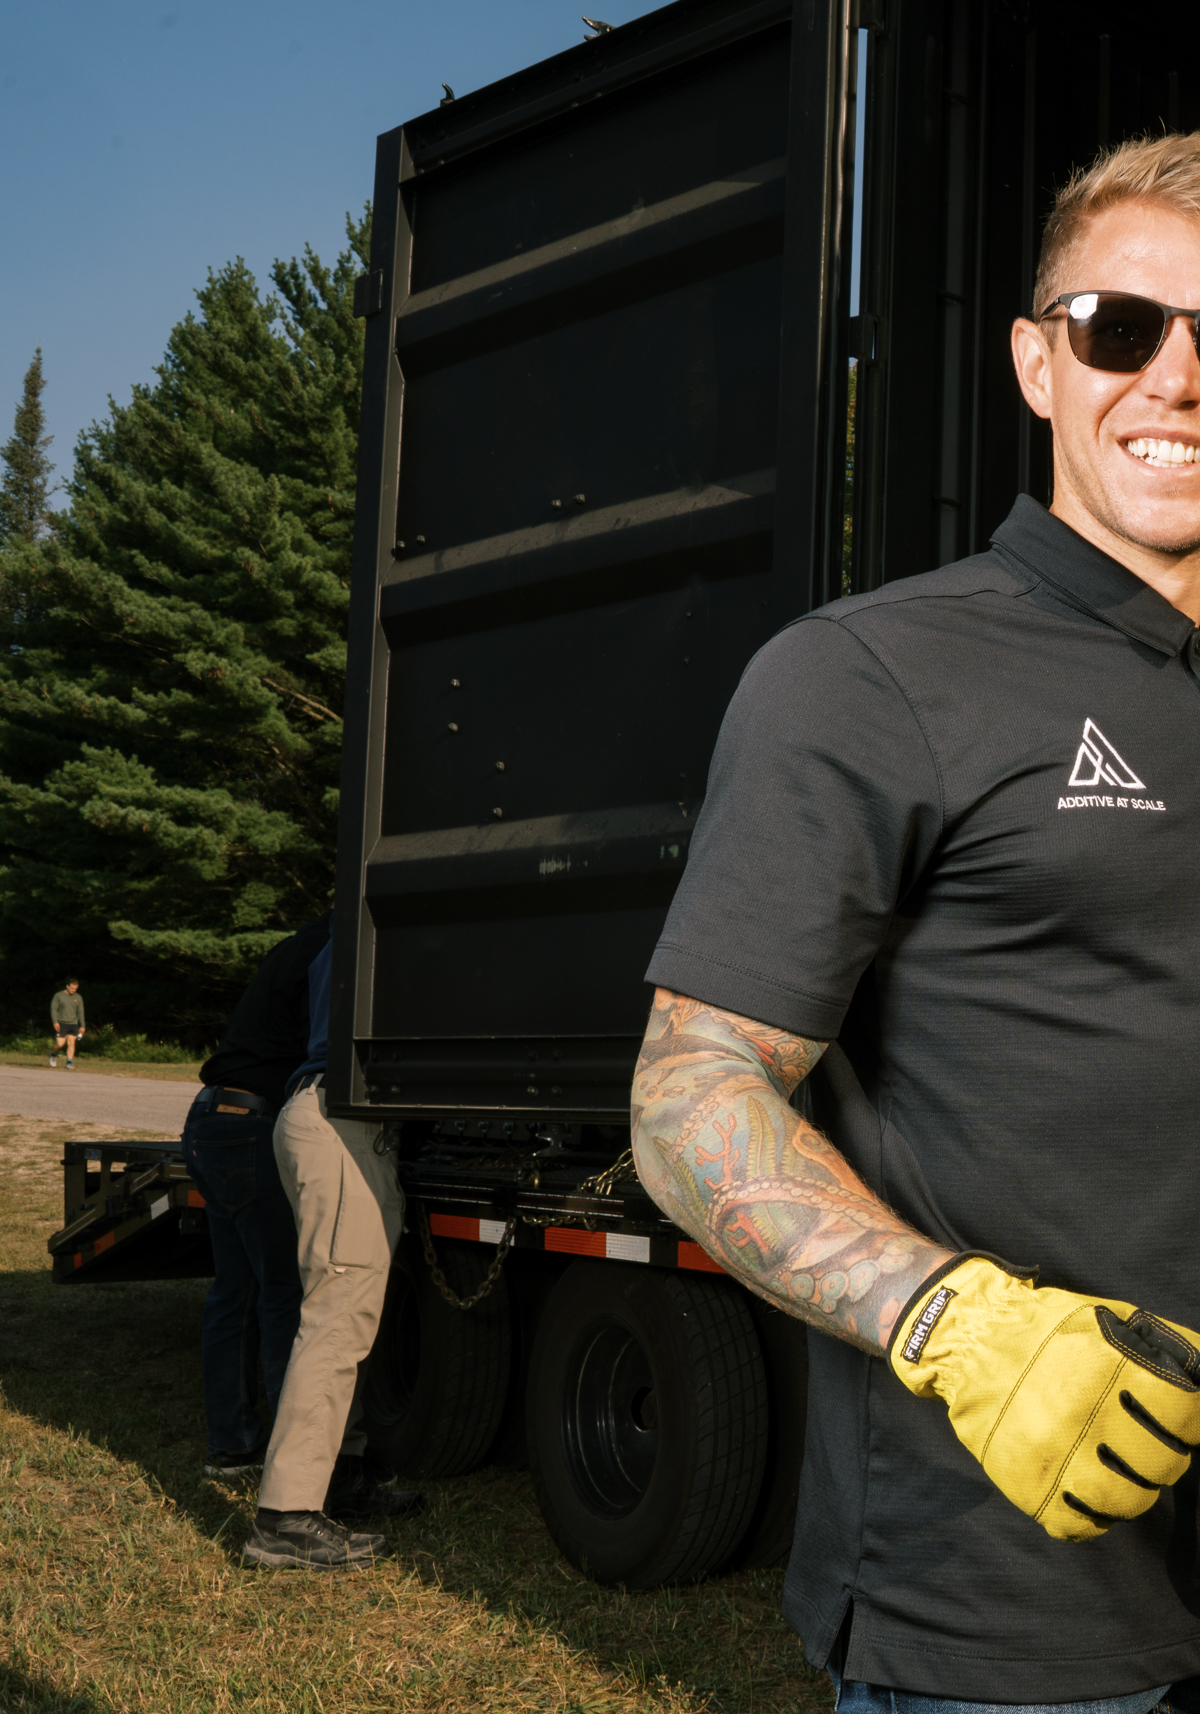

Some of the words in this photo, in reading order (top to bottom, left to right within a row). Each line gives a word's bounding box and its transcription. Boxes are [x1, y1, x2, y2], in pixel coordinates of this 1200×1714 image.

[1057, 795, 1115, 810] ADDITIVE
[1116, 797, 1129, 808] AT
[1130, 798, 1167, 811] SCALE
[905, 1323, 929, 1359] FIRM
[921, 1289, 947, 1325] GRIP
